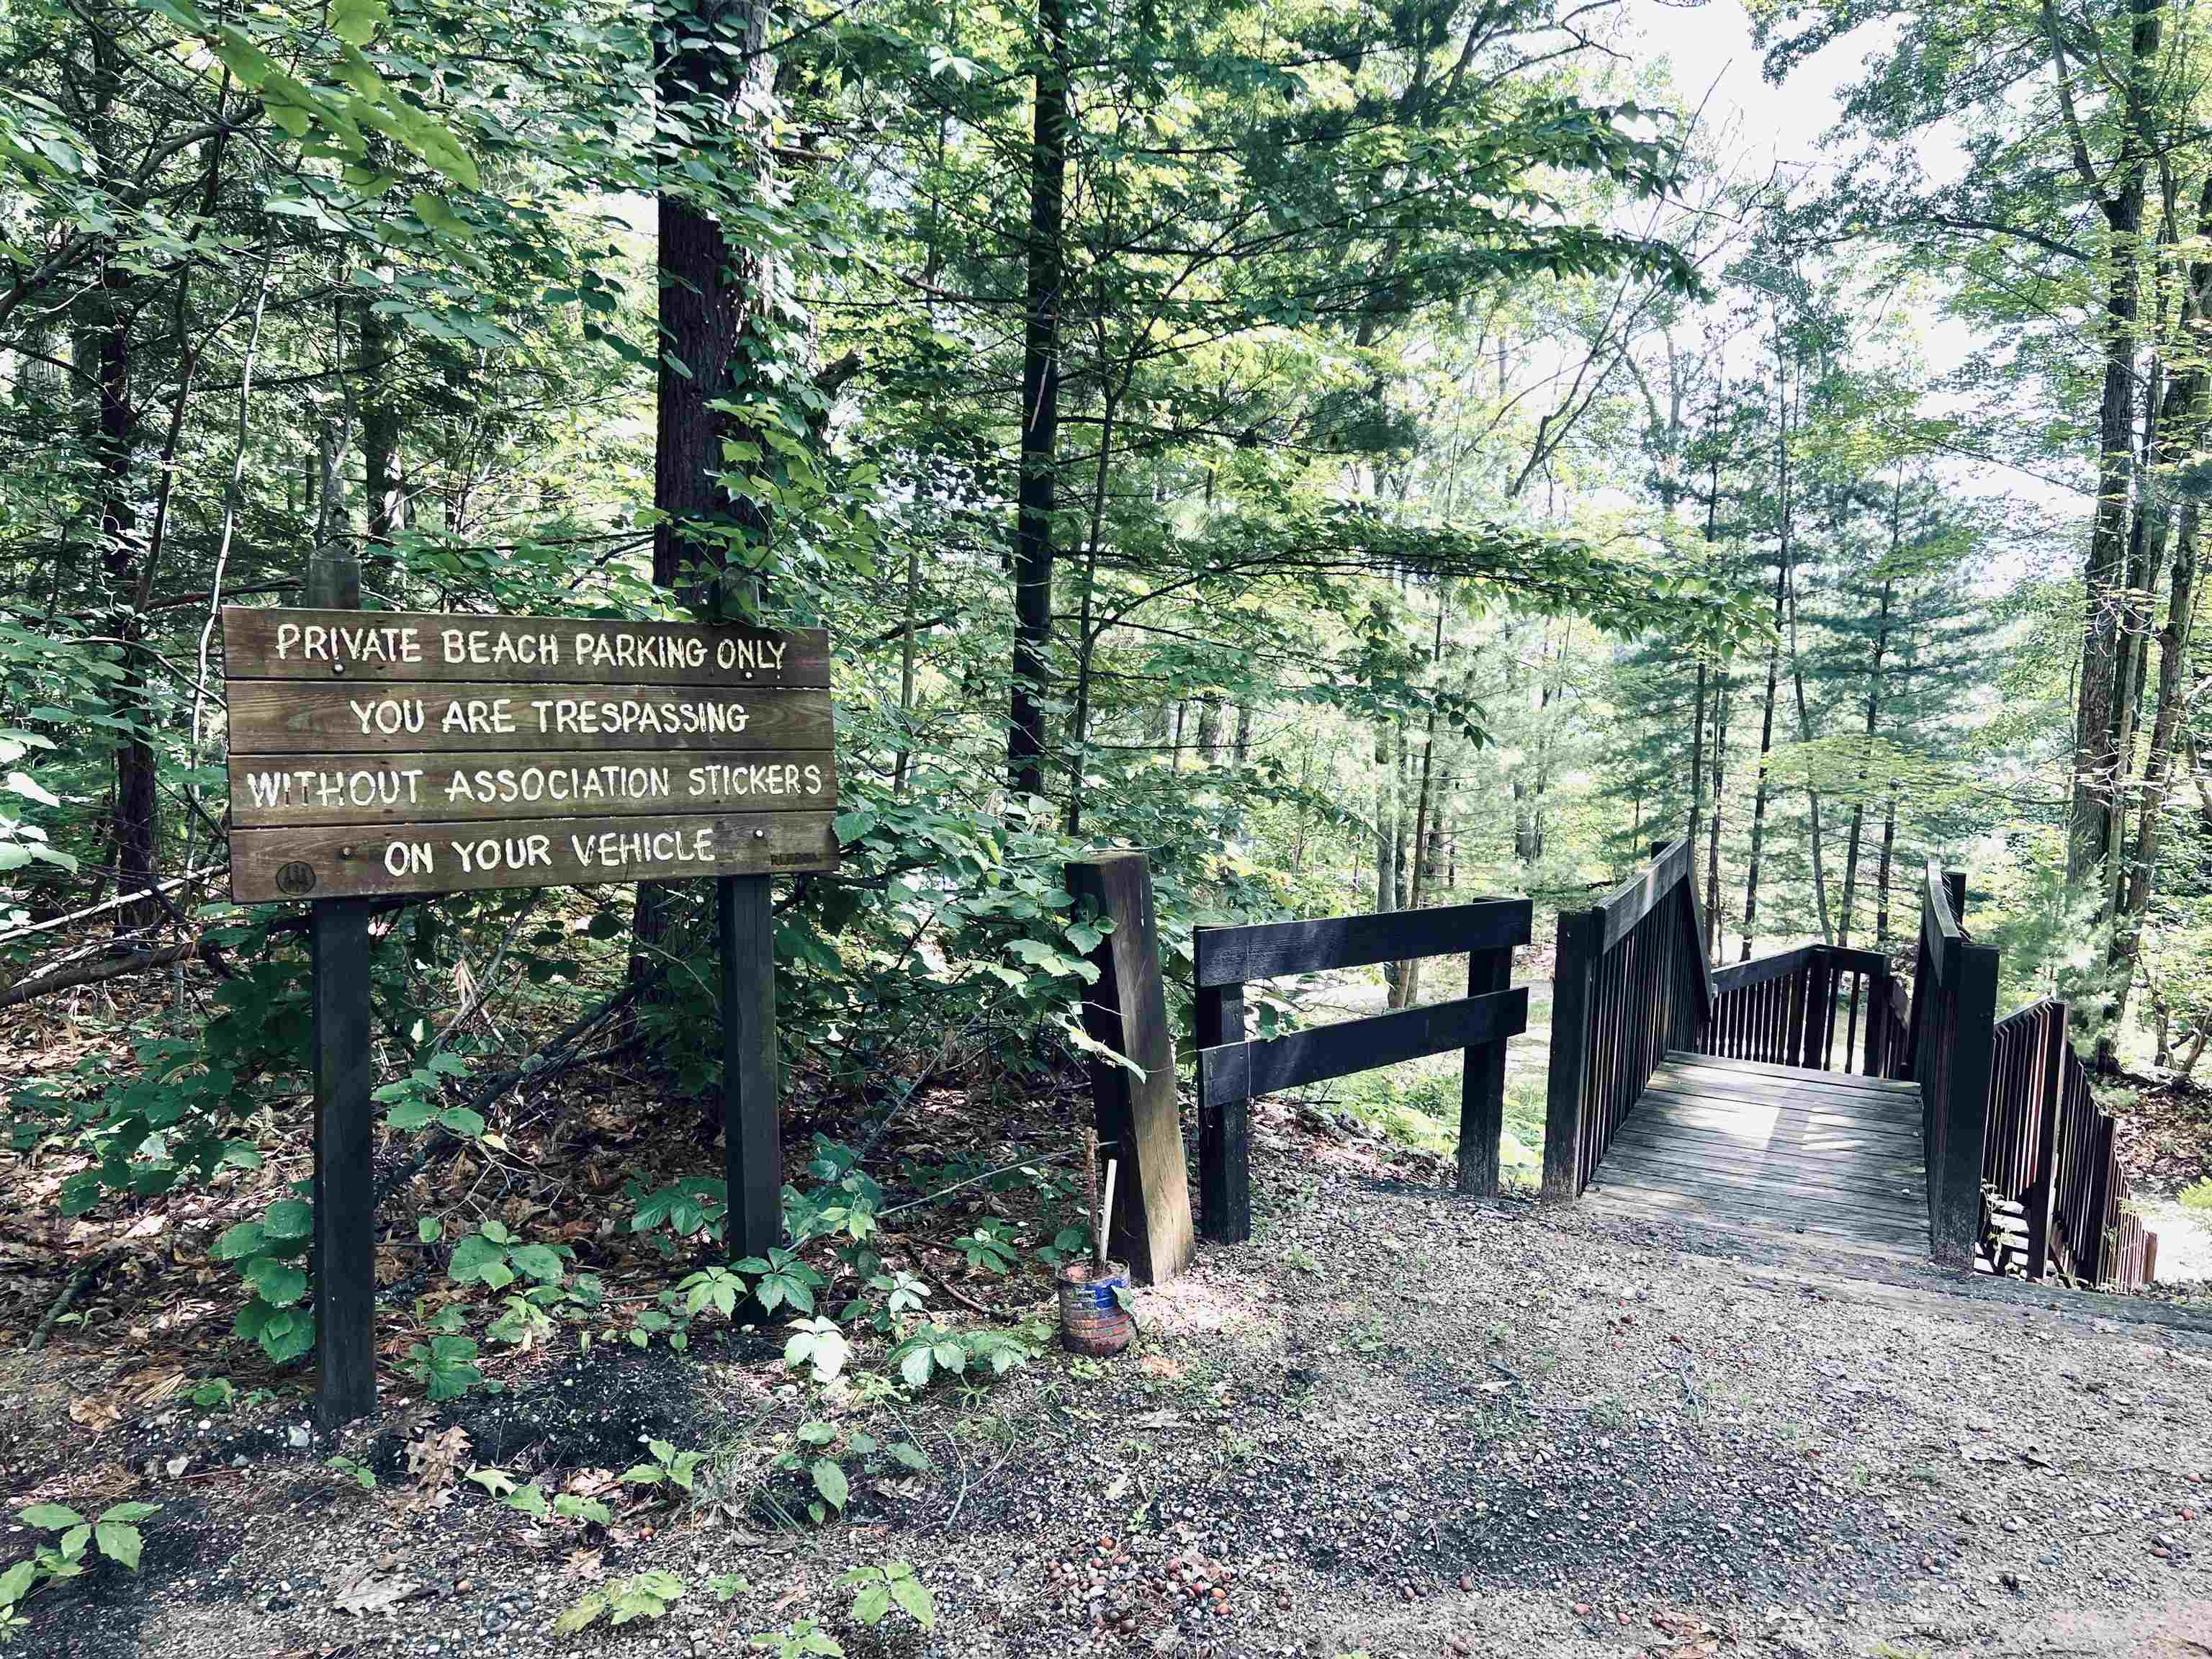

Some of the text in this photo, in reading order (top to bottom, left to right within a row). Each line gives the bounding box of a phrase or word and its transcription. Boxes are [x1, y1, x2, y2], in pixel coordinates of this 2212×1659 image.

[276, 624, 786, 671] PRIVATE BEACH PARKING ONLY
[350, 698, 750, 734] YOU ARE TRESPASSING
[247, 765, 822, 808] WITHOUT ASSOCIATION STICKERS
[385, 828, 715, 877] ON YOUR VEHICLE
